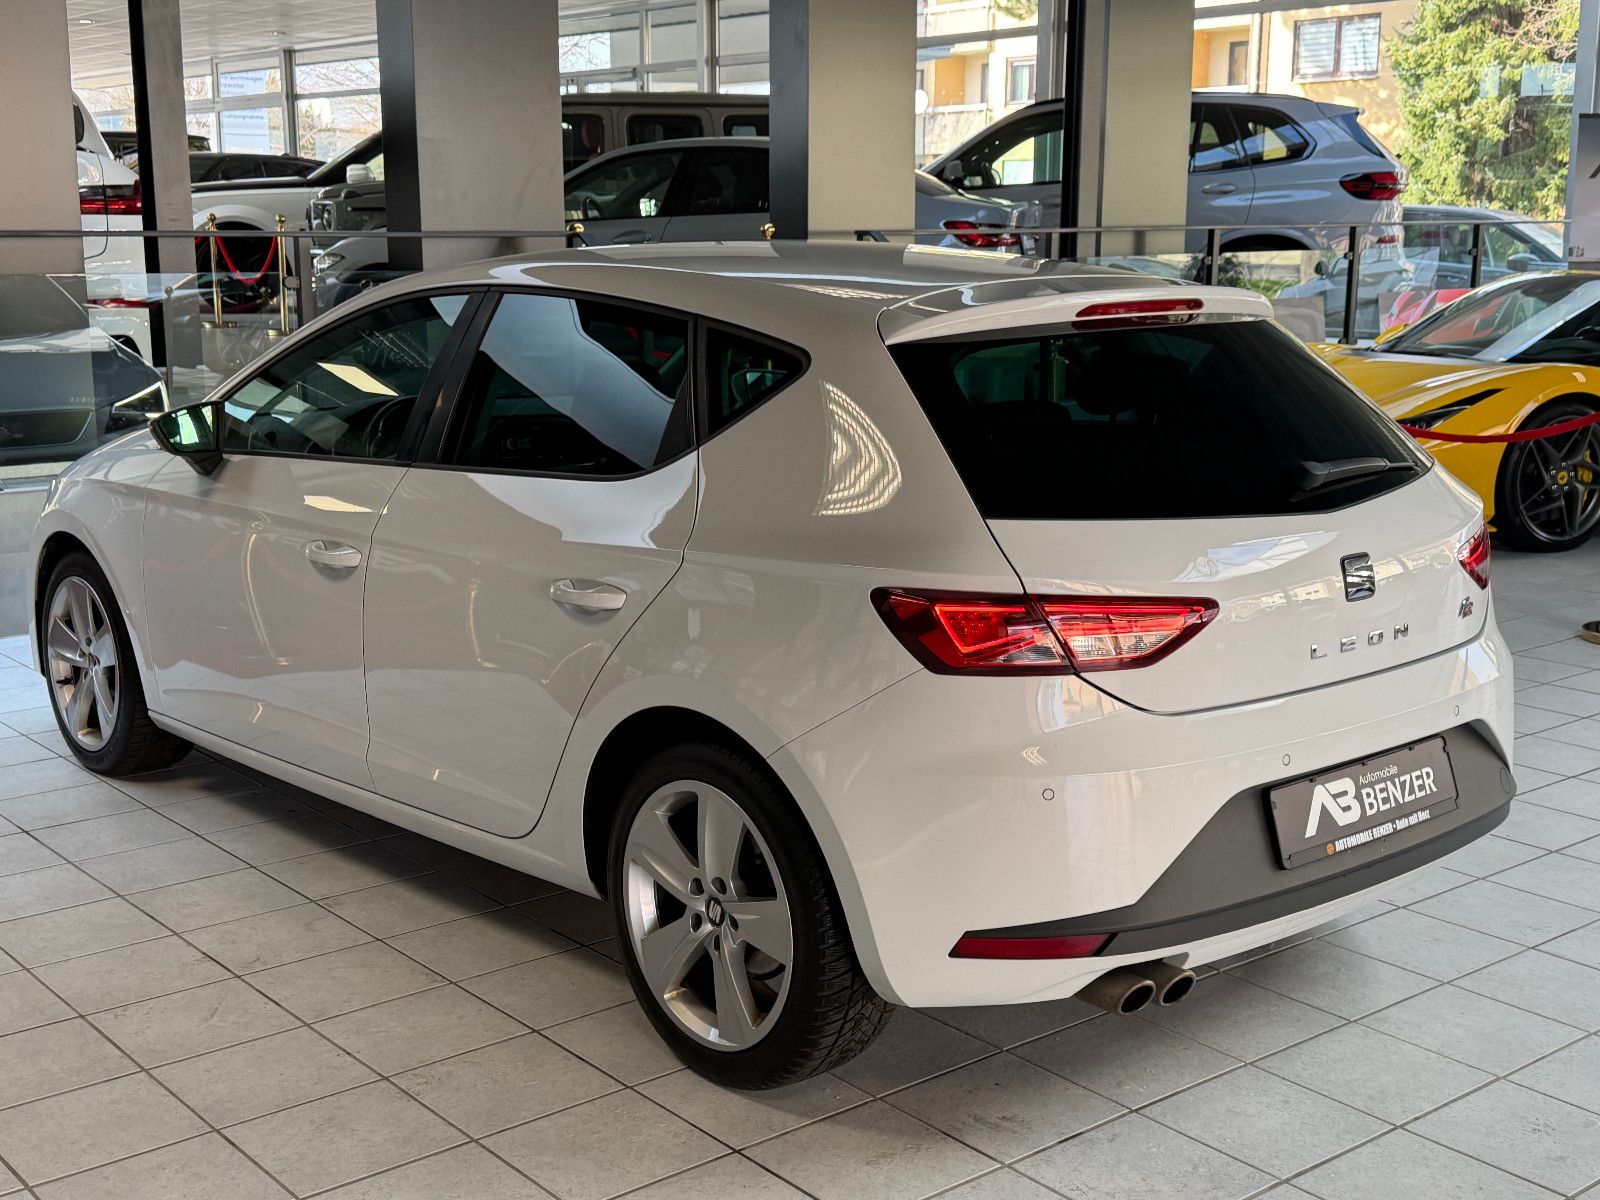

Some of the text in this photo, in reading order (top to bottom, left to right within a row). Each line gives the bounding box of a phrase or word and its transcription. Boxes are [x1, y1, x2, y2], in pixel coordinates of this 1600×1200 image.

[1310, 623, 1409, 659] LEON
[1359, 765, 1398, 785] Automobile
[1360, 766, 1437, 817] BENZER
[1335, 829, 1374, 852] AUTOMOBILE
